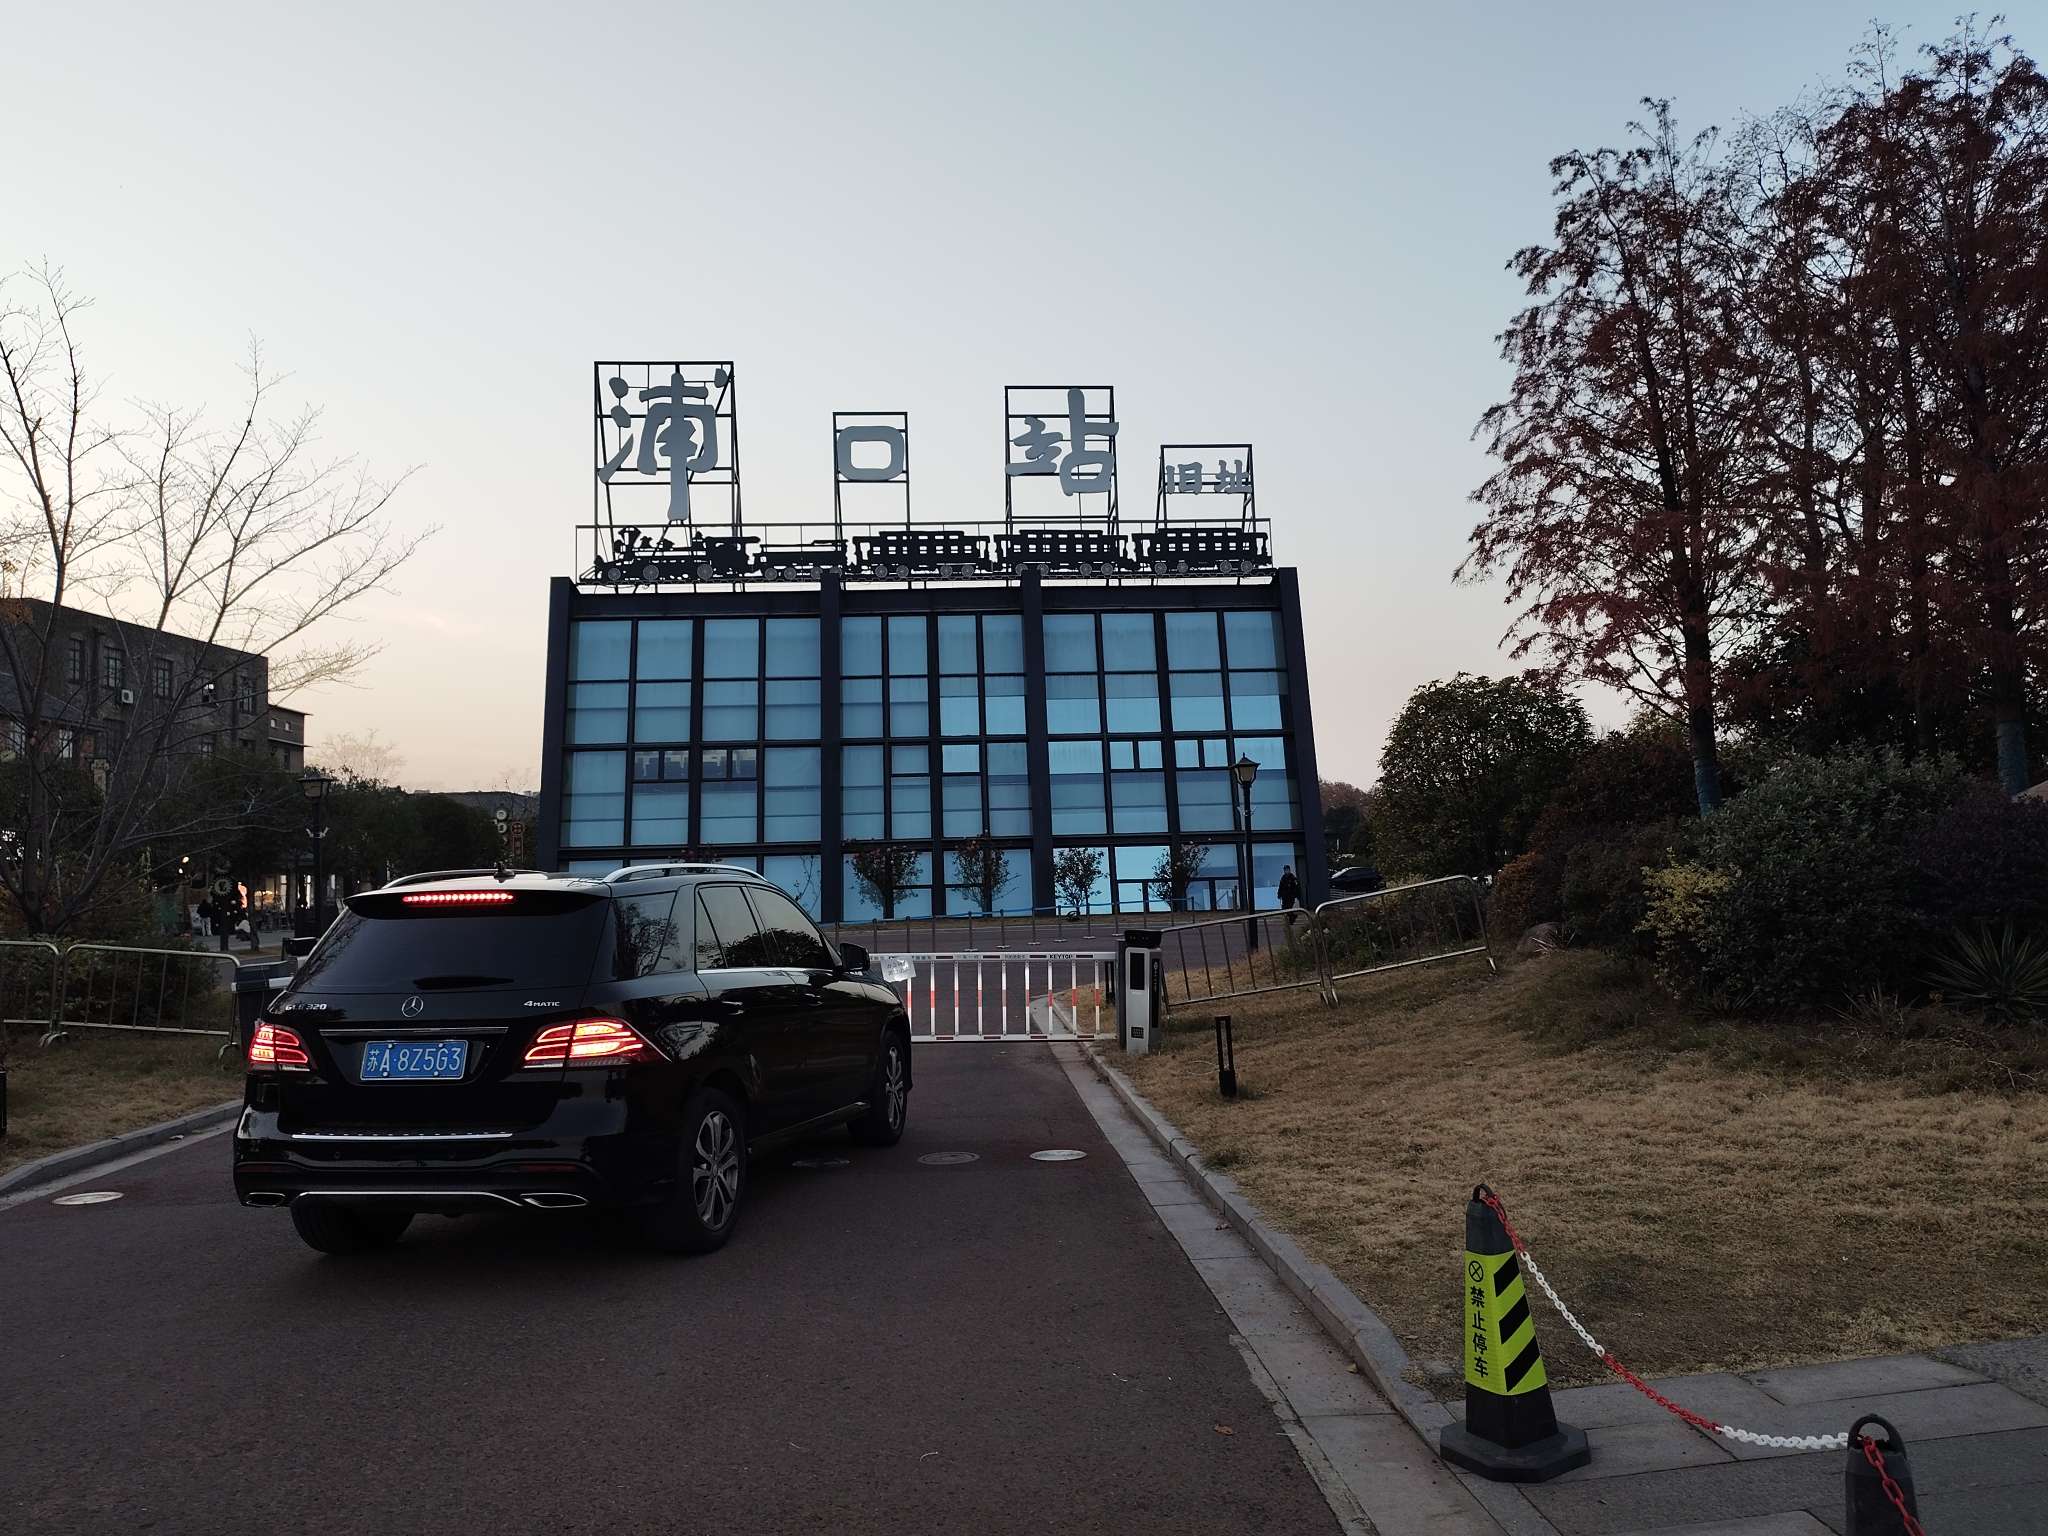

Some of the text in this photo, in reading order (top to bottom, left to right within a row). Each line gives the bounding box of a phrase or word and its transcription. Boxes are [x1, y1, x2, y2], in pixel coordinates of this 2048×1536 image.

[305, 1002, 328, 1011] 320
[1469, 1285, 1489, 1378] 禁止停车
